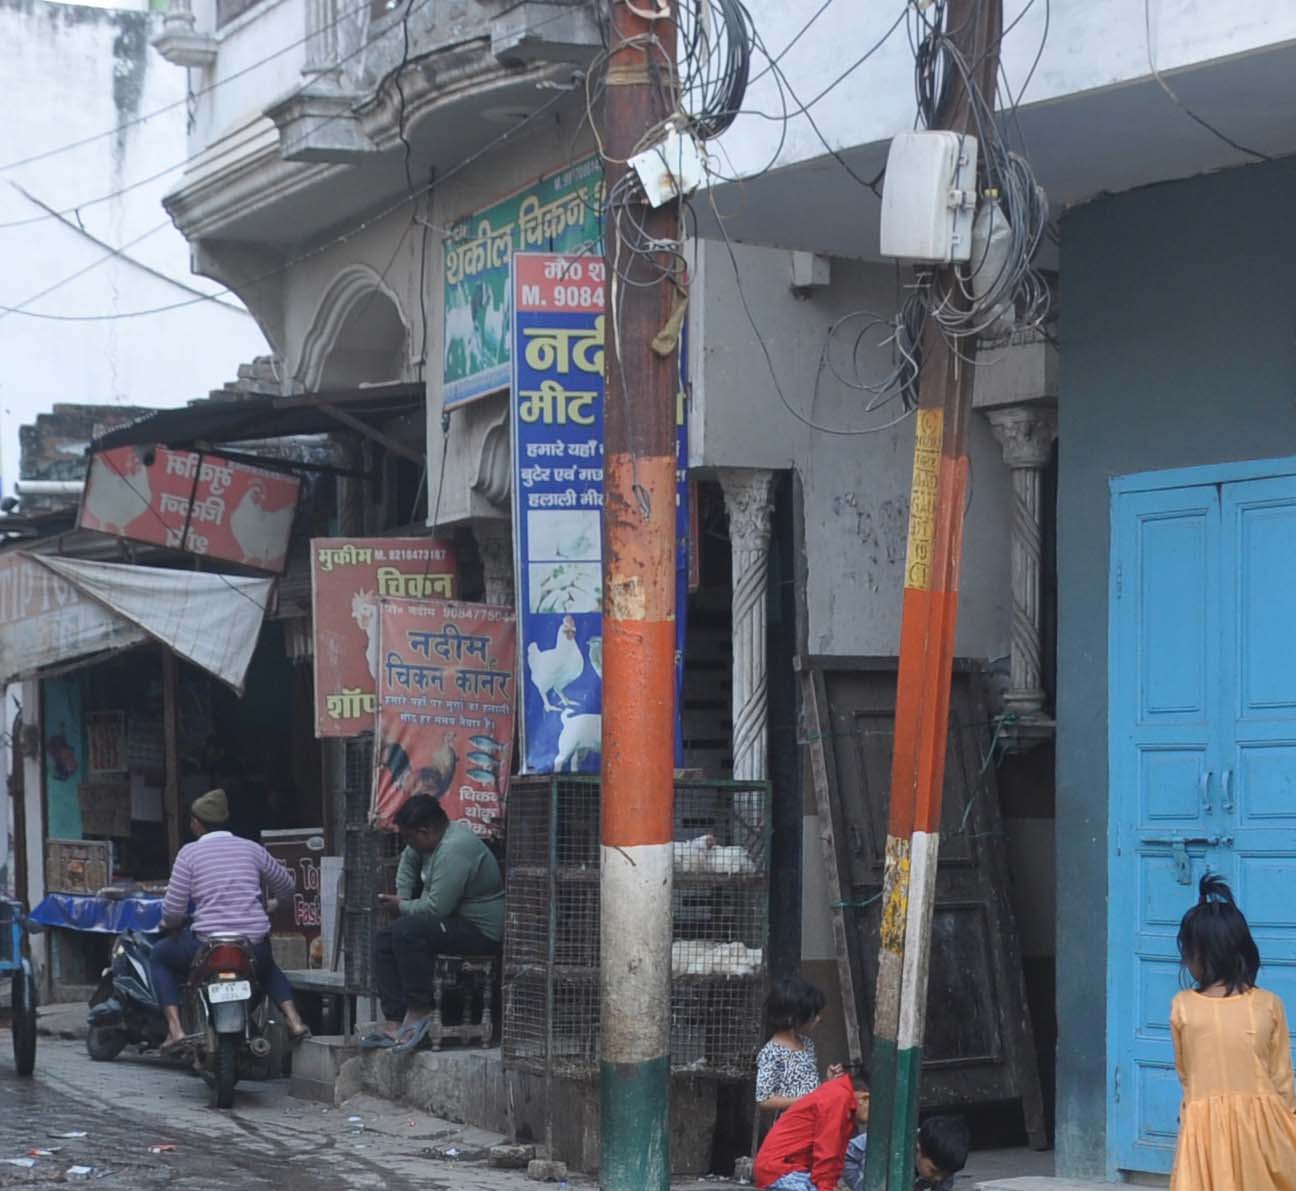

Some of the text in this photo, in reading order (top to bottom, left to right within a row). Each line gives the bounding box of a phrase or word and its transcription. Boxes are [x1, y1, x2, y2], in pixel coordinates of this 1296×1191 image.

[518, 195, 589, 250] चिकन
[522, 284, 546, 305] M.
[519, 379, 598, 424] मीट
[318, 544, 373, 572] मुकीम
[377, 567, 454, 598] चिकन
[407, 622, 492, 663] नदीम
[384, 650, 445, 692] चिकन
[299, 857, 322, 896] To
